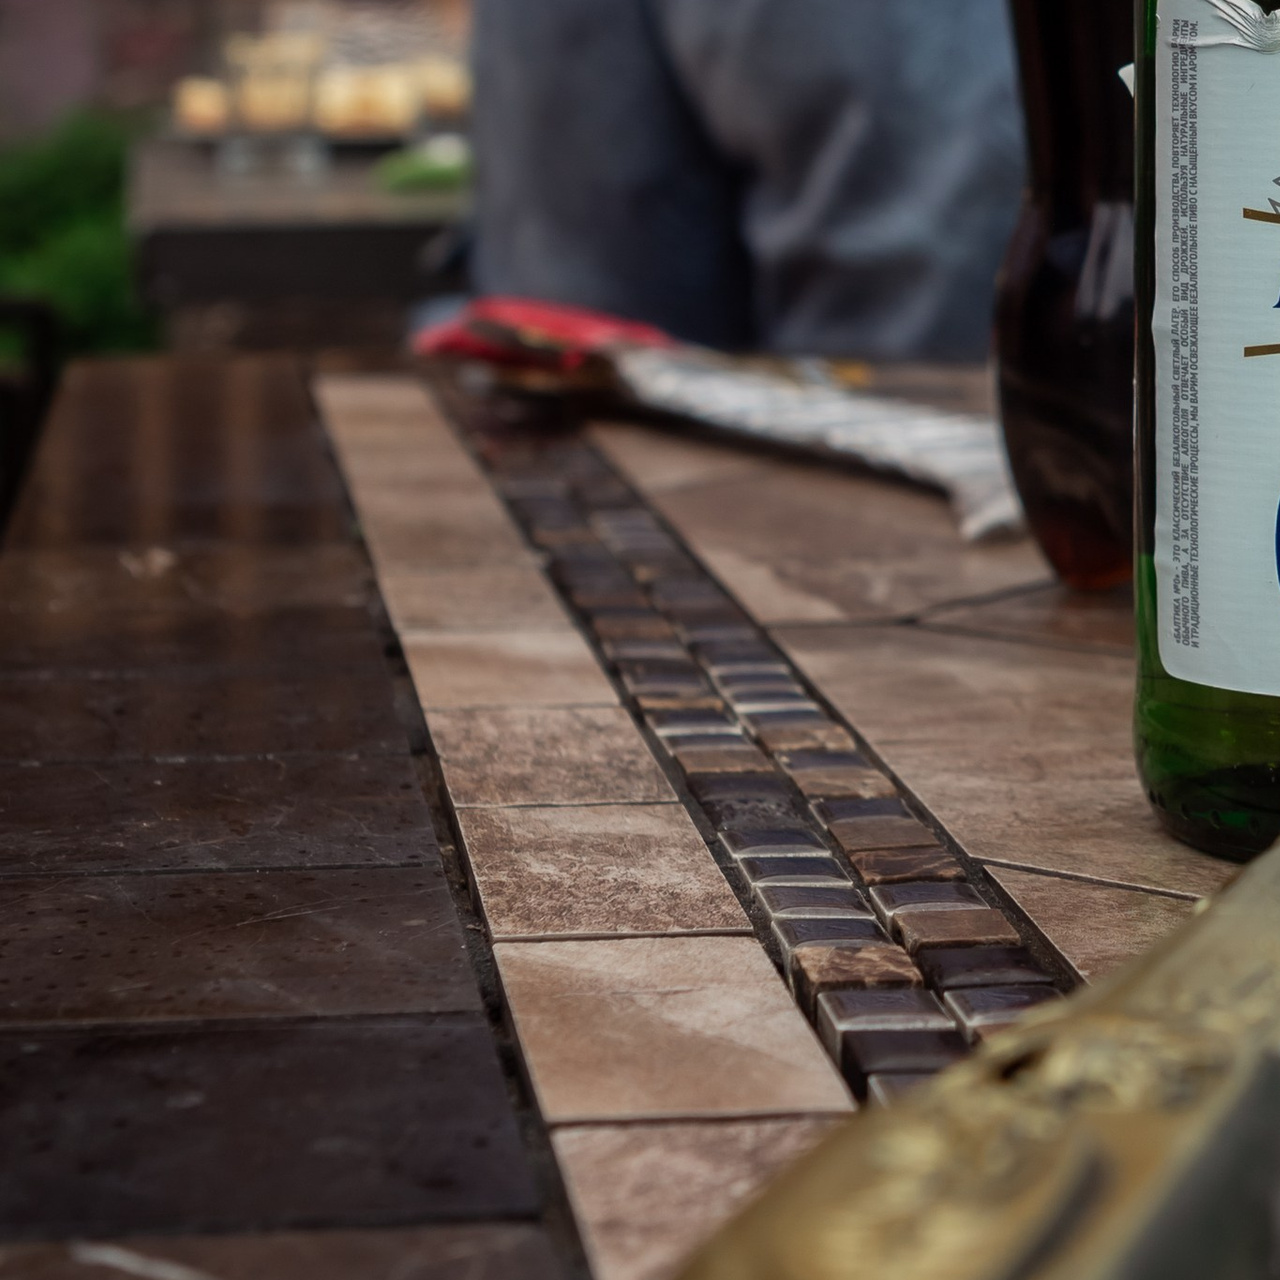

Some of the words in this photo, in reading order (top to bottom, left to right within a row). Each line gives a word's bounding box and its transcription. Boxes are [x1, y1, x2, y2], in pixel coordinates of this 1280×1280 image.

[1171, 51, 1180, 113] ТЕХНОЛОГИЮ
[1189, 82, 1198, 120] ВКУСОМ
[1171, 117, 1180, 169] ПОВТОРЯЕТ
[1180, 91, 1188, 157] НАТУРАЛЬНЫЕ
[1189, 121, 1198, 189] НАСЫЩЕННЫМ
[1172, 172, 1180, 244] ПРОИЗВОДСТВА
[1180, 164, 1189, 218] ИСПОЛЬЗУЯ
[1189, 197, 1198, 223] ПИВО
[1172, 246, 1180, 283] СПОСОБ
[1180, 224, 1189, 275] ДРОЖЖЕЙ.
[1189, 223, 1198, 305] БЕЗАЛКОГОЛЬНОЕ
[1172, 285, 1180, 303] ЕГО
[1180, 281, 1189, 302] ВИД
[1171, 305, 1180, 336] ЛАГЕР.
[1180, 308, 1189, 348] ОСОБЫЙ
[1189, 306, 1199, 371] ОСВЕЖАЮЩЕЕ
[1171, 339, 1180, 382] СВЕТЛЫЙ
[1180, 354, 1189, 401] ОТВЕЧАЕТ
[1190, 372, 1198, 404] ВАРИМ
[1190, 405, 1198, 422] МЫ
[1172, 384, 1181, 468] БЕЗАЛКОГОЛЬНЫЙ
[1180, 408, 1189, 457] АЛКОГОЛЯ
[1190, 423, 1200, 475] ПРОЦЕССЫ,
[1172, 470, 1181, 542] КЛАССИЧЕСКИЙ
[1180, 463, 1189, 521] ОТСУТСТВИЕ
[1181, 528, 1189, 541] ЗА
[1190, 475, 1199, 562] ТЕХНОЛОГИЧЕСКИЕ
[1181, 562, 1191, 590] ПИВА,
[1190, 564, 1200, 639] ТРАДИЦИОННЫЕ
[1181, 596, 1190, 647] ОБЫЧНОГО
